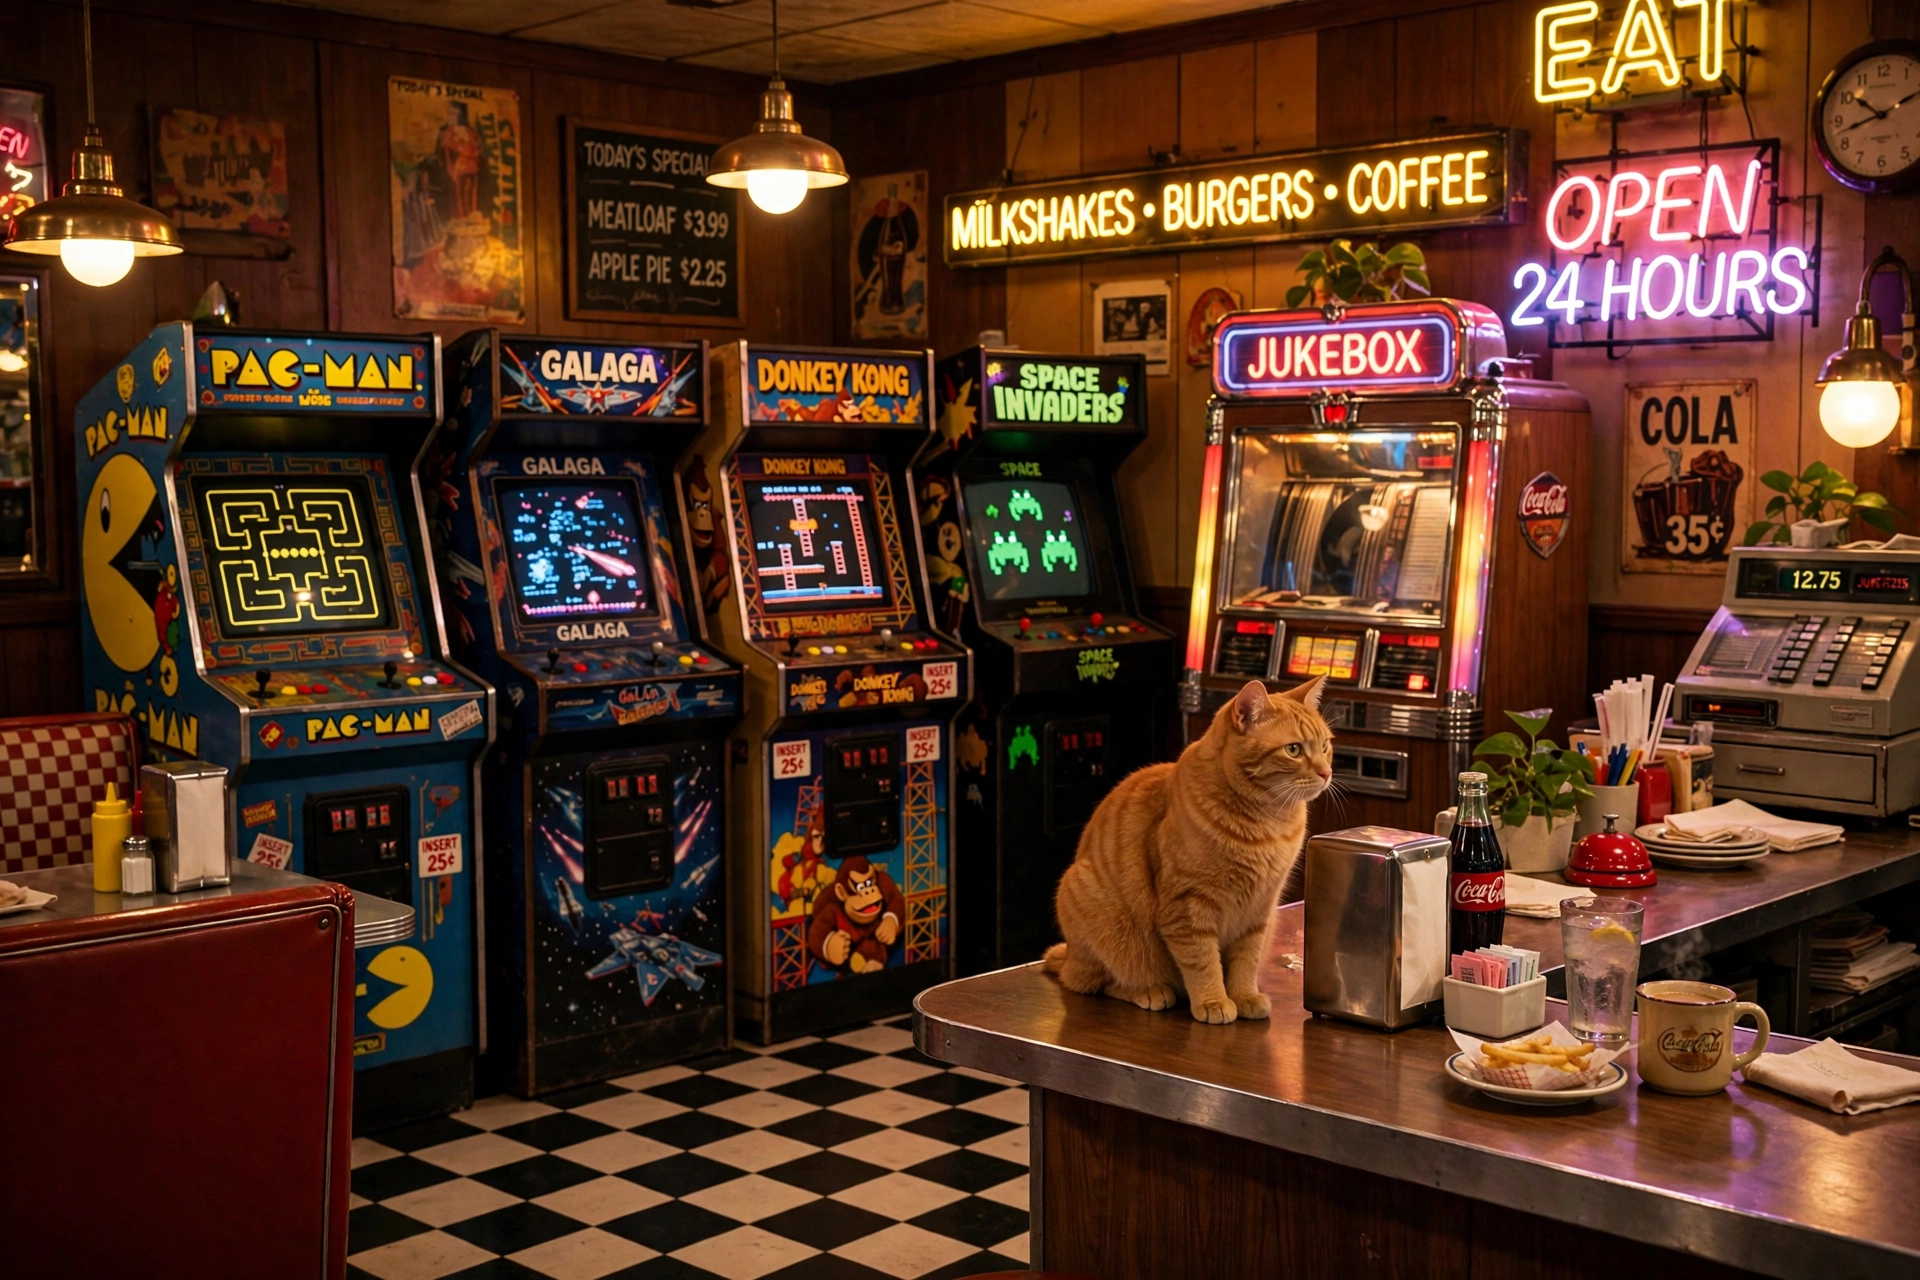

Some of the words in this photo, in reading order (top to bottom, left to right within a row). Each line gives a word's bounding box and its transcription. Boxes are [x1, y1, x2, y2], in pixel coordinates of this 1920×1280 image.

[1534, 0, 1724, 103] EAT
[1858, 73, 1867, 86] 11
[1877, 64, 1890, 78] 12
[1840, 91, 1854, 104] 10
[1834, 115, 1843, 128] 9
[1840, 137, 1849, 150] 8
[1901, 146, 1910, 160] 5
[584, 142, 646, 170] TODAY'S
[1856, 151, 1864, 164] 7
[1877, 155, 1886, 168] 6
[1163, 169, 1315, 232] BURGERS
[1347, 150, 1489, 215] COFFEE
[1545, 160, 1762, 251] OPEN
[588, 199, 677, 234] MEATLOAF
[683, 210, 729, 239] $3.99
[588, 251, 641, 282] APPLE
[646, 254, 672, 283] PIE
[680, 258, 727, 288] $2.25
[1511, 261, 1584, 327] 24
[1600, 246, 1808, 323] HOURS
[1247, 328, 1422, 379] JUKEBOX
[210, 348, 413, 390] PAC-MAN
[541, 349, 658, 384] GALAGA
[757, 358, 848, 393] DONKEY
[851, 363, 909, 396] KONG
[1019, 363, 1100, 392] SPACE
[993, 385, 1126, 424] INVADERS
[84, 403, 168, 458] PAC-MAN
[1640, 395, 1739, 446] COLA
[522, 457, 606, 475] GALAGA
[762, 458, 811, 475] DONKEY
[813, 458, 846, 475] KONG
[1000, 461, 1042, 477] SPACE
[1665, 514, 1724, 555] 35¢
[1792, 570, 1841, 590] 12.75
[556, 621, 630, 641] GALAGA
[930, 679, 951, 695] 25¢
[305, 708, 431, 743] PAC-MAN
[913, 742, 934, 759] 25¢
[781, 757, 804, 774] 25¢
[422, 837, 458, 853] INSERT
[427, 852, 455, 872] 25¢
